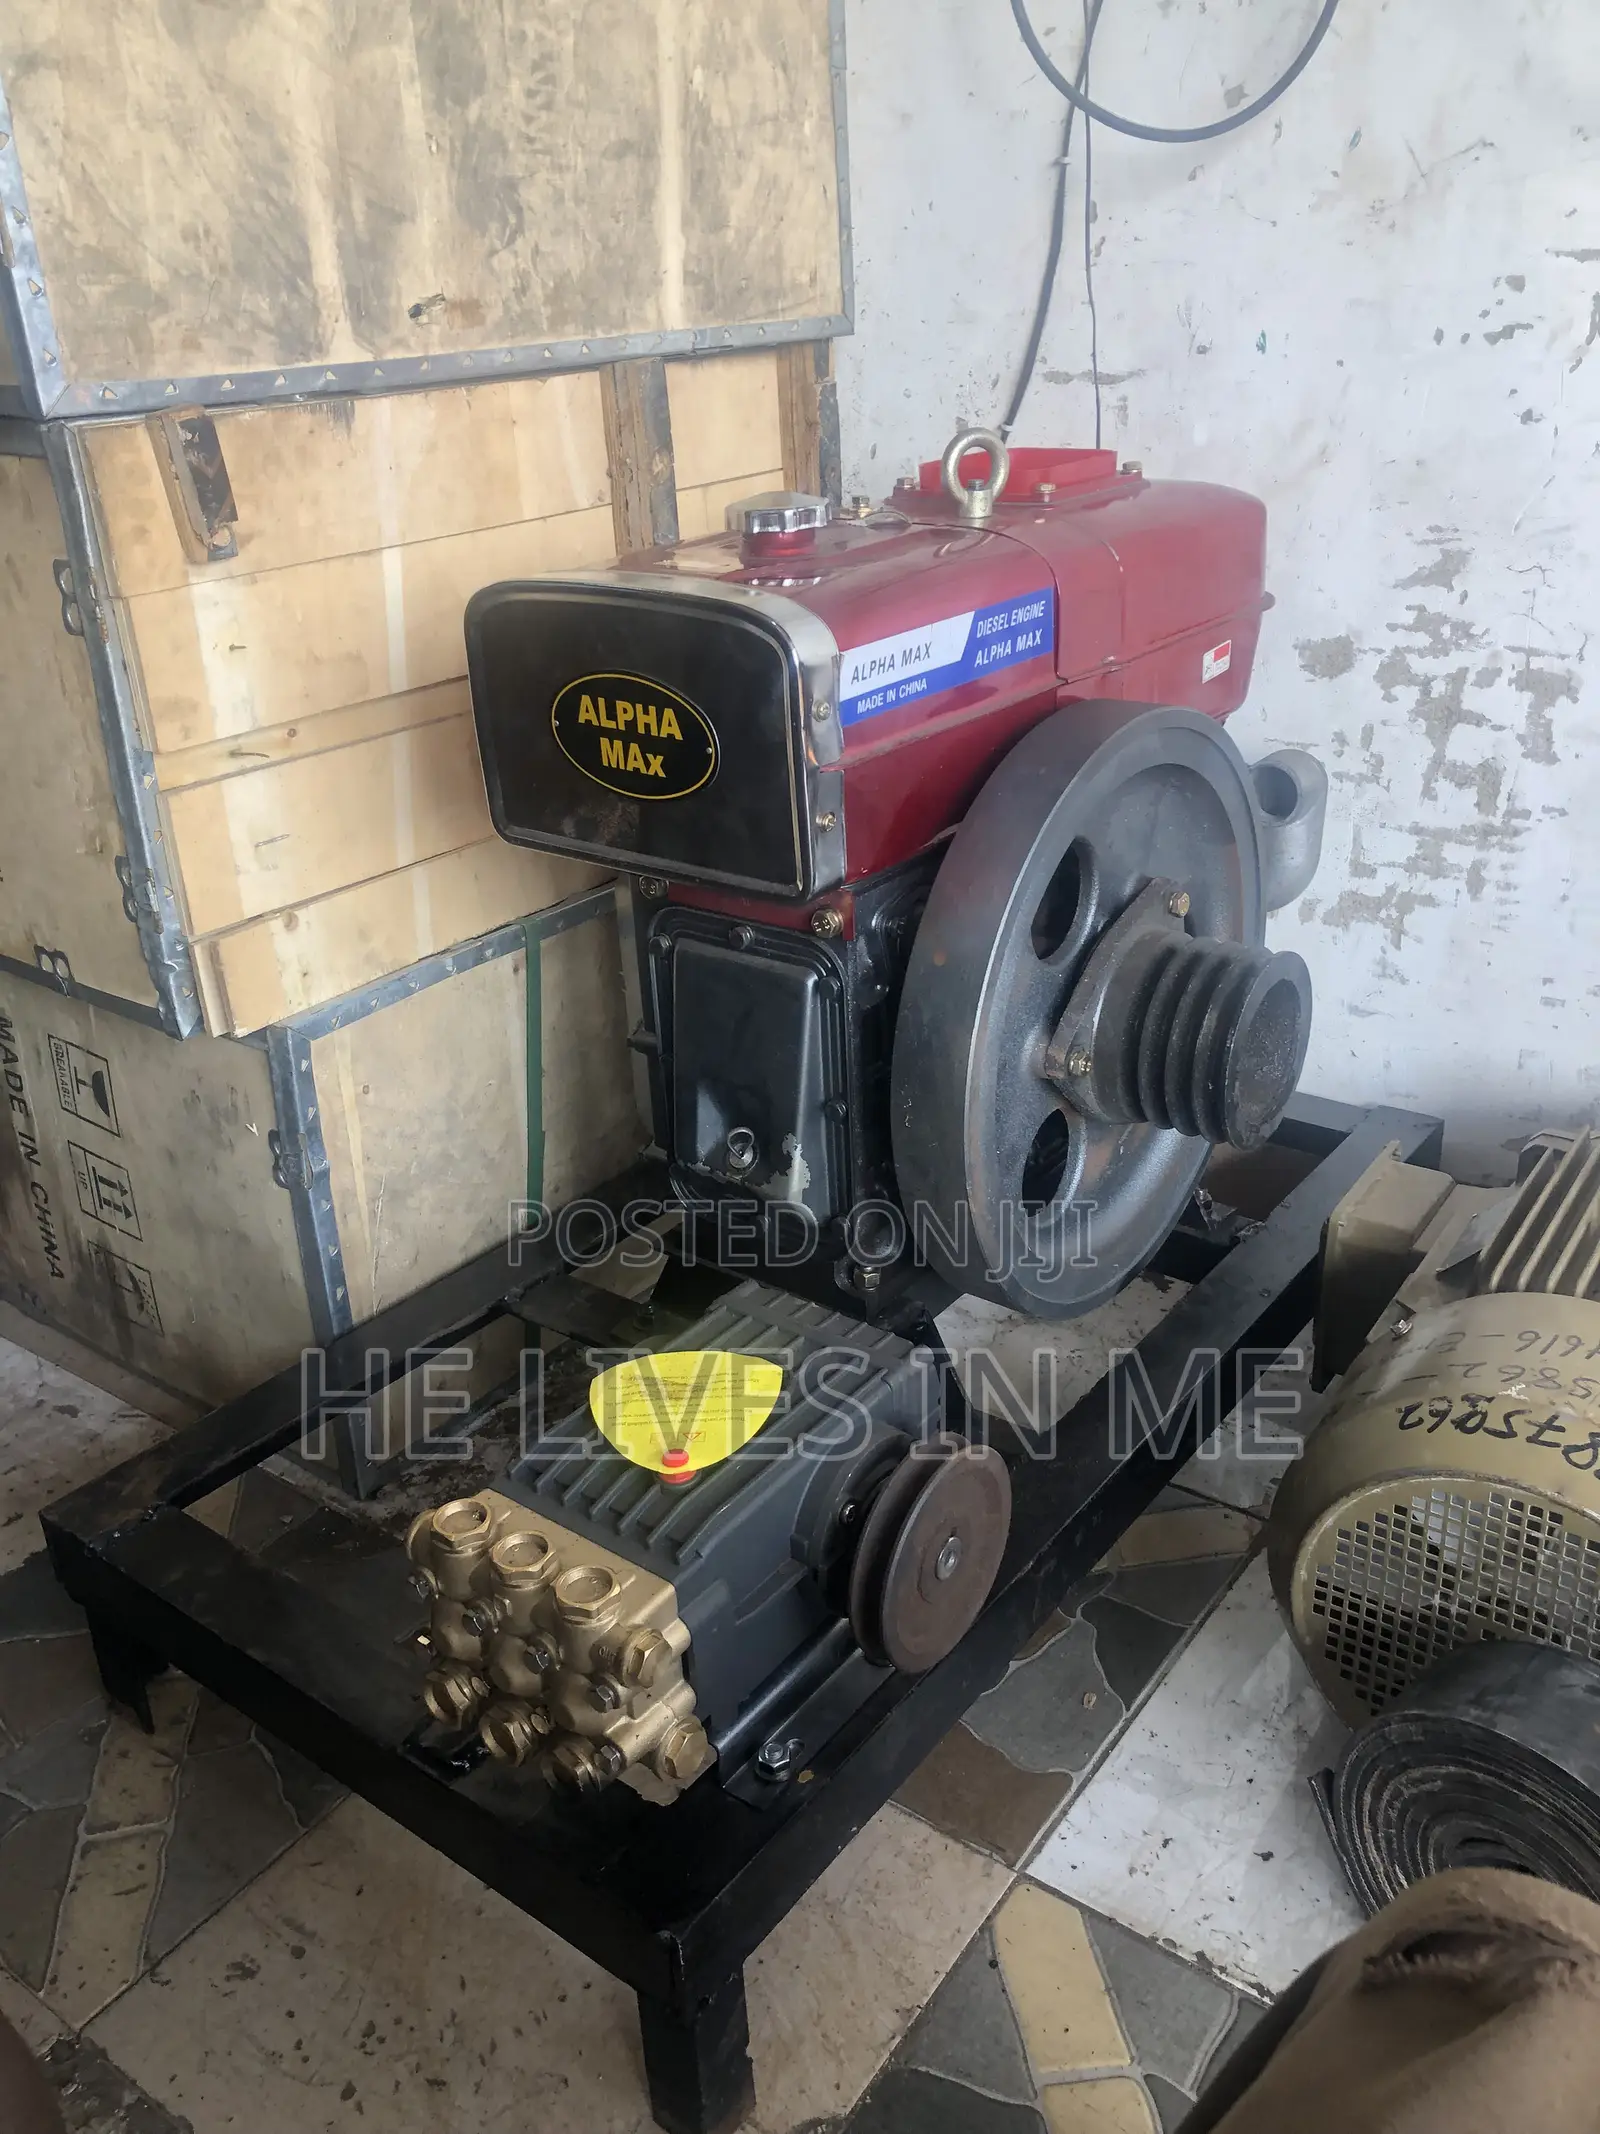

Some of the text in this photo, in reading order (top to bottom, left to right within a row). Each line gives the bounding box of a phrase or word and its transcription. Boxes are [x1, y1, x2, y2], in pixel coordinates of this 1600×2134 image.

[977, 600, 1046, 638] DIESEL ENGINE
[850, 641, 933, 685] ALPHA MAX
[974, 628, 1043, 668] ALPHA MAX
[856, 677, 928, 715] MADE IN CHINA
[578, 694, 684, 741] ALPHA
[0, 1015, 29, 1119] MADE
[18, 1130, 41, 1167] IN
[30, 1180, 65, 1279] CHINA
[76, 1171, 90, 1191] UP
